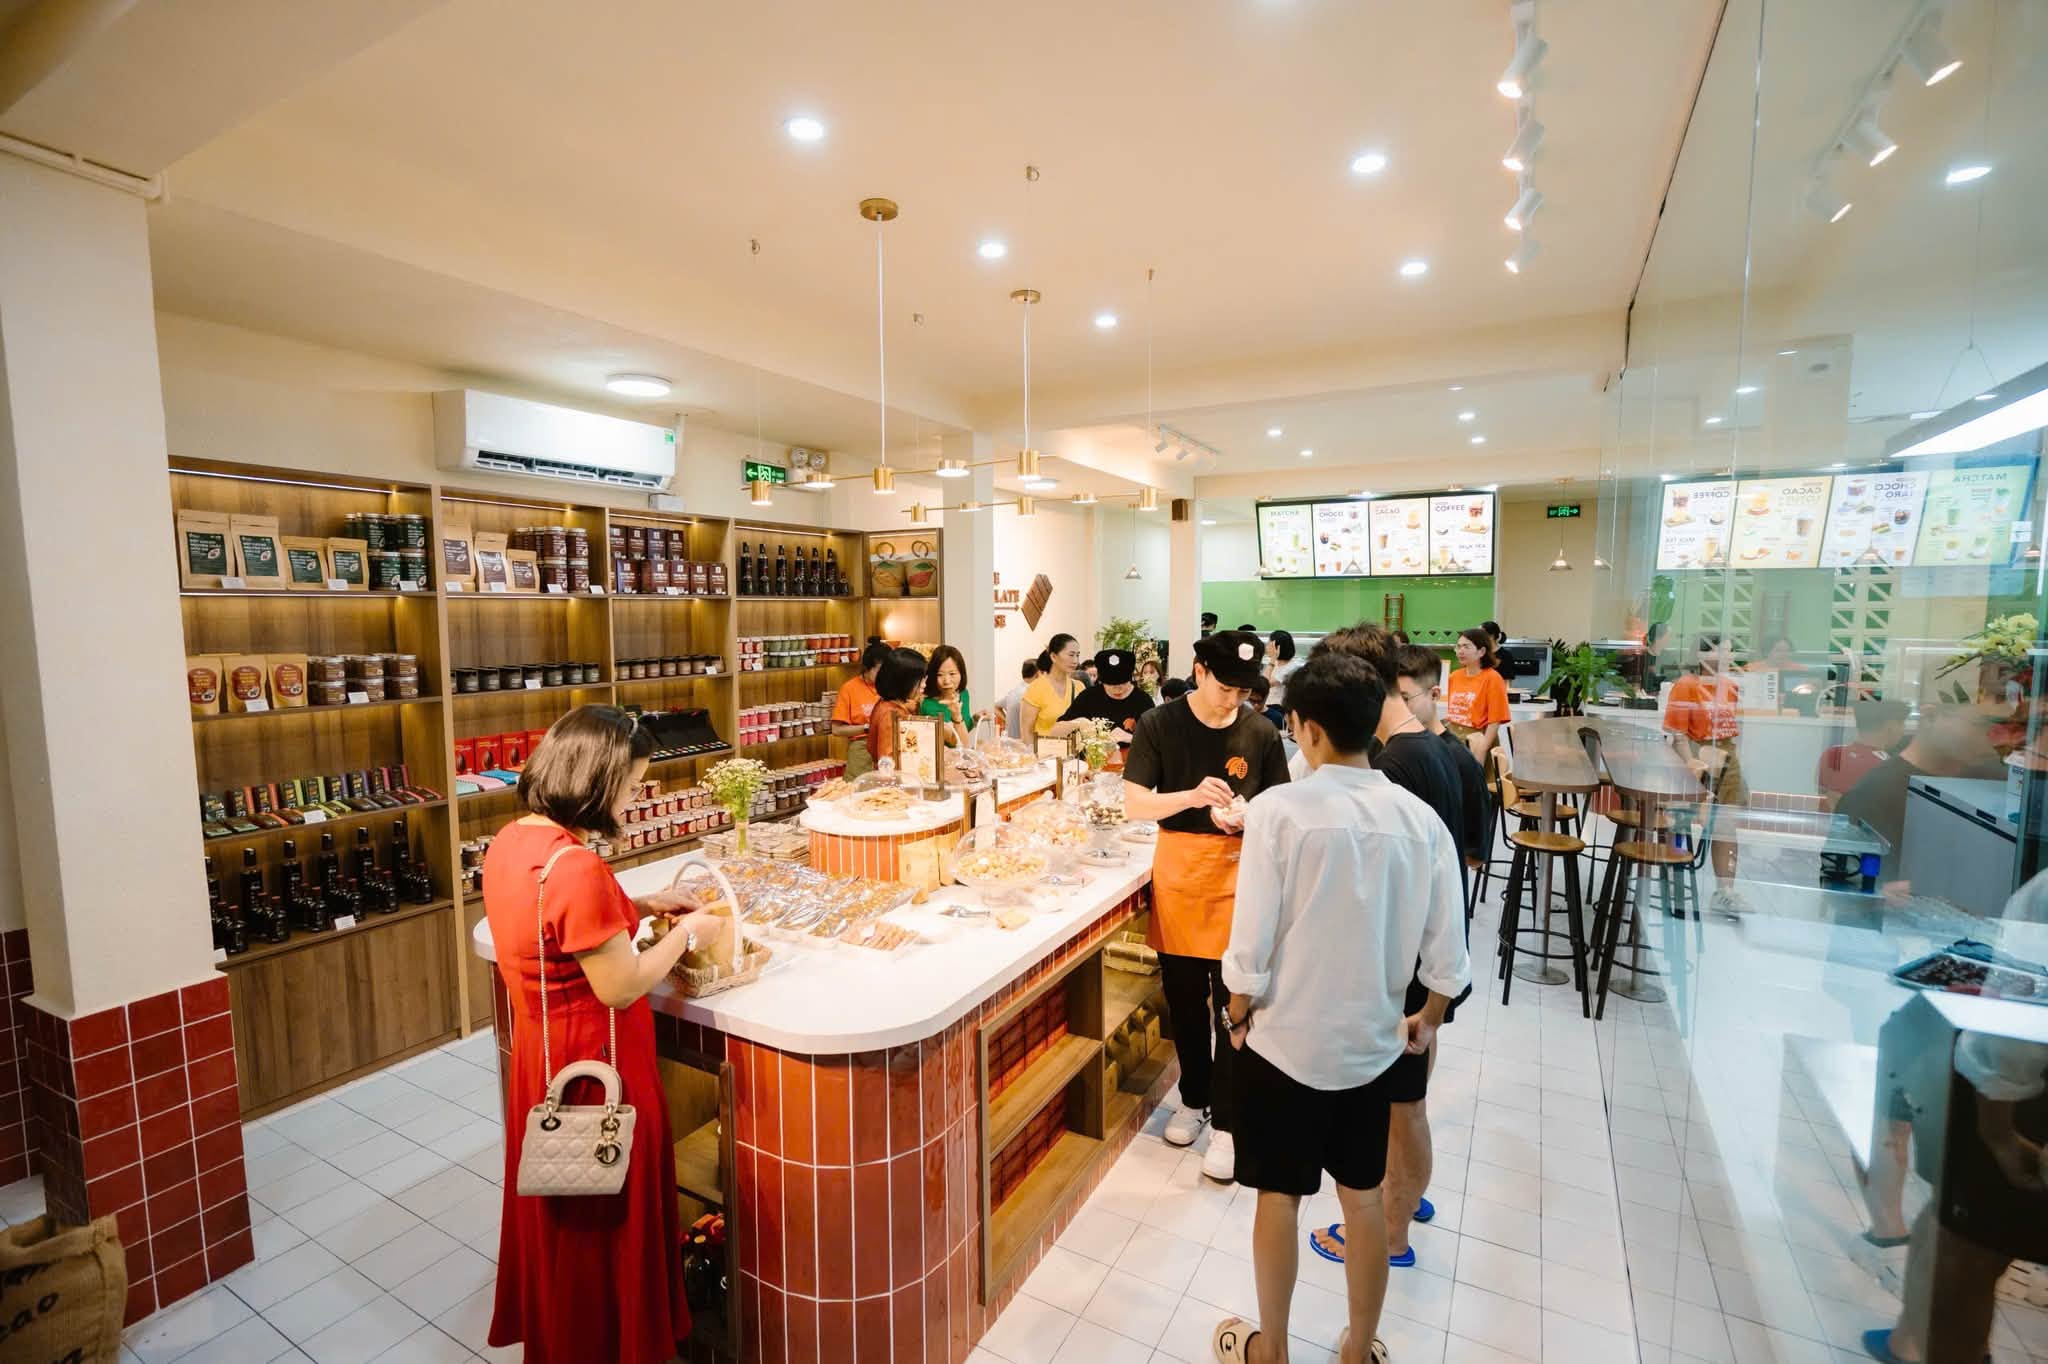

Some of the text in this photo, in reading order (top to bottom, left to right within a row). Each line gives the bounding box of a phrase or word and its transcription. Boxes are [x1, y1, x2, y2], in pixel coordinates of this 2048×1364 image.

[1375, 506, 1400, 515] CACAO
[1434, 504, 1465, 512] COFFEE
[993, 589, 1020, 603] LATE
